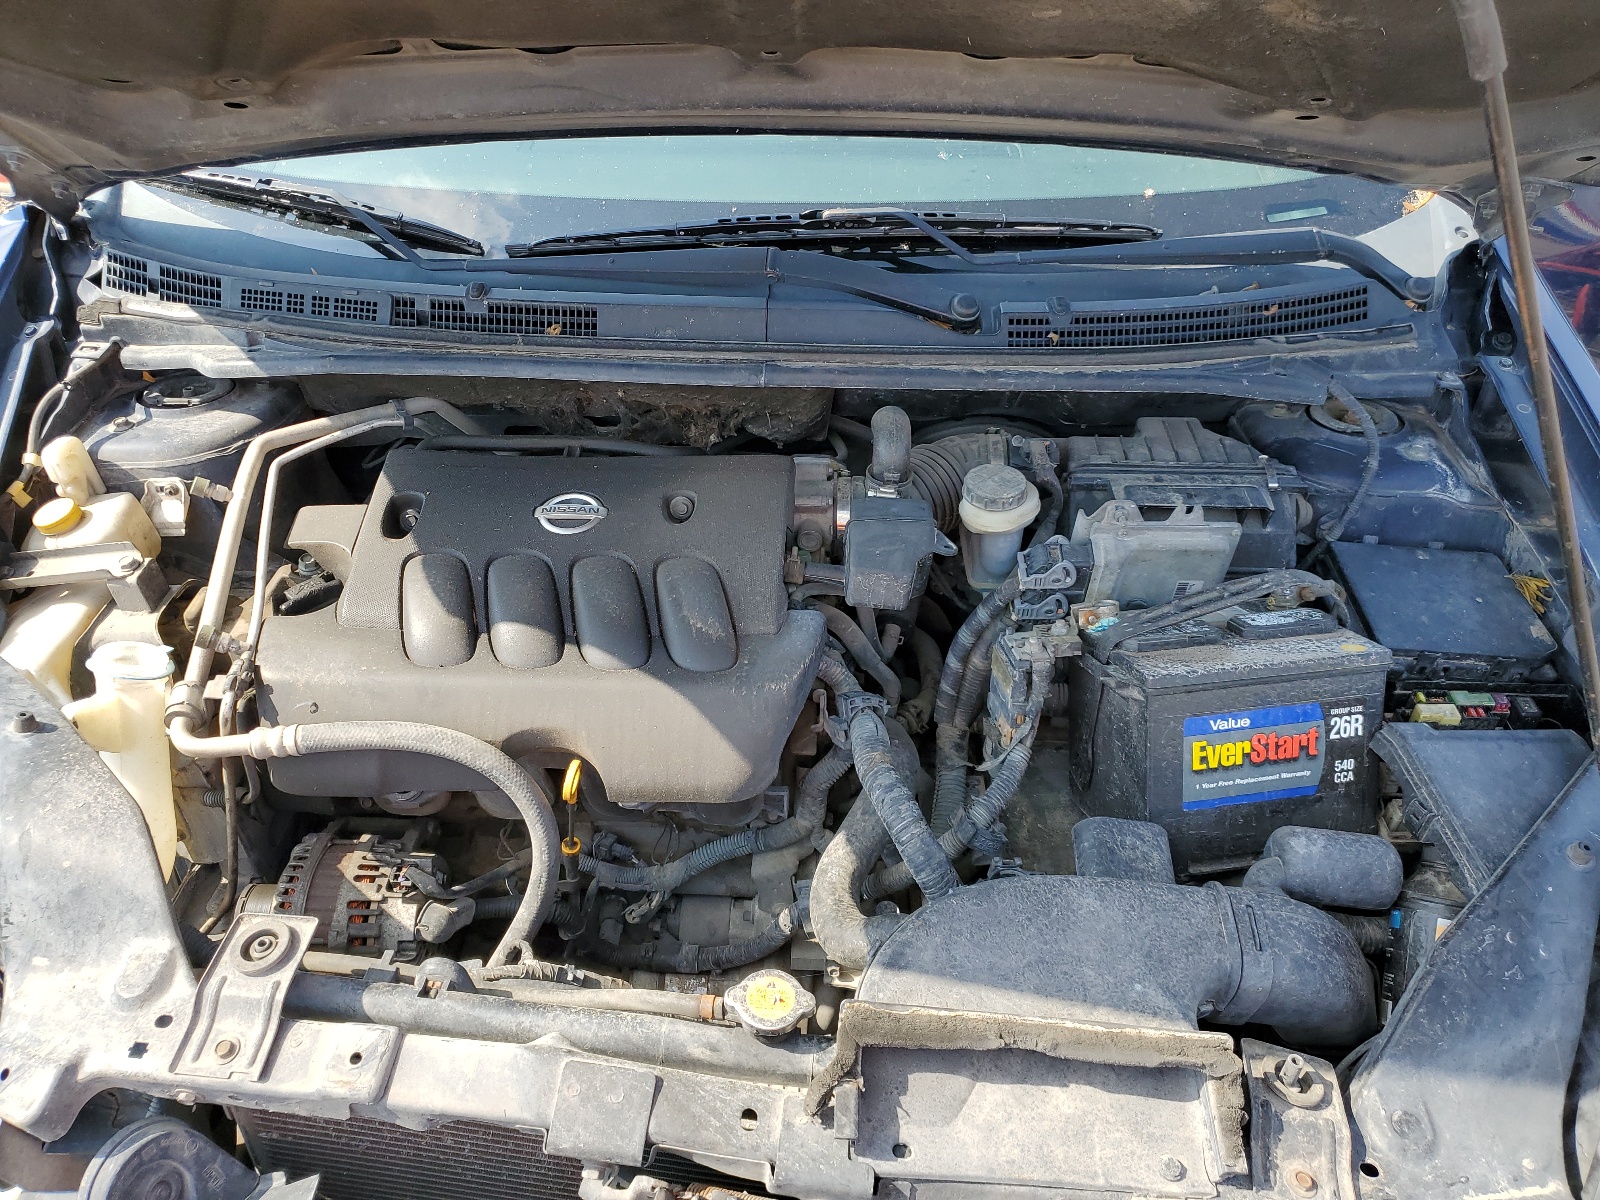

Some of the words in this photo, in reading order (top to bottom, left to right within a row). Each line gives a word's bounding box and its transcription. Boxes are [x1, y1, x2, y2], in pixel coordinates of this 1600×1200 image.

[541, 506, 600, 514] NISSAN
[1330, 707, 1350, 715] GROUP
[1350, 705, 1363, 713] SIZE
[1210, 717, 1251, 731] Value
[1329, 714, 1363, 740] 26R
[1192, 727, 1319, 771] EverStart
[1334, 759, 1355, 772] 540
[1202, 781, 1217, 789] Year
[1218, 779, 1234, 787] Free
[1235, 773, 1279, 785] Replacement
[1281, 770, 1311, 779] Warranty
[1334, 771, 1354, 783] CCA
